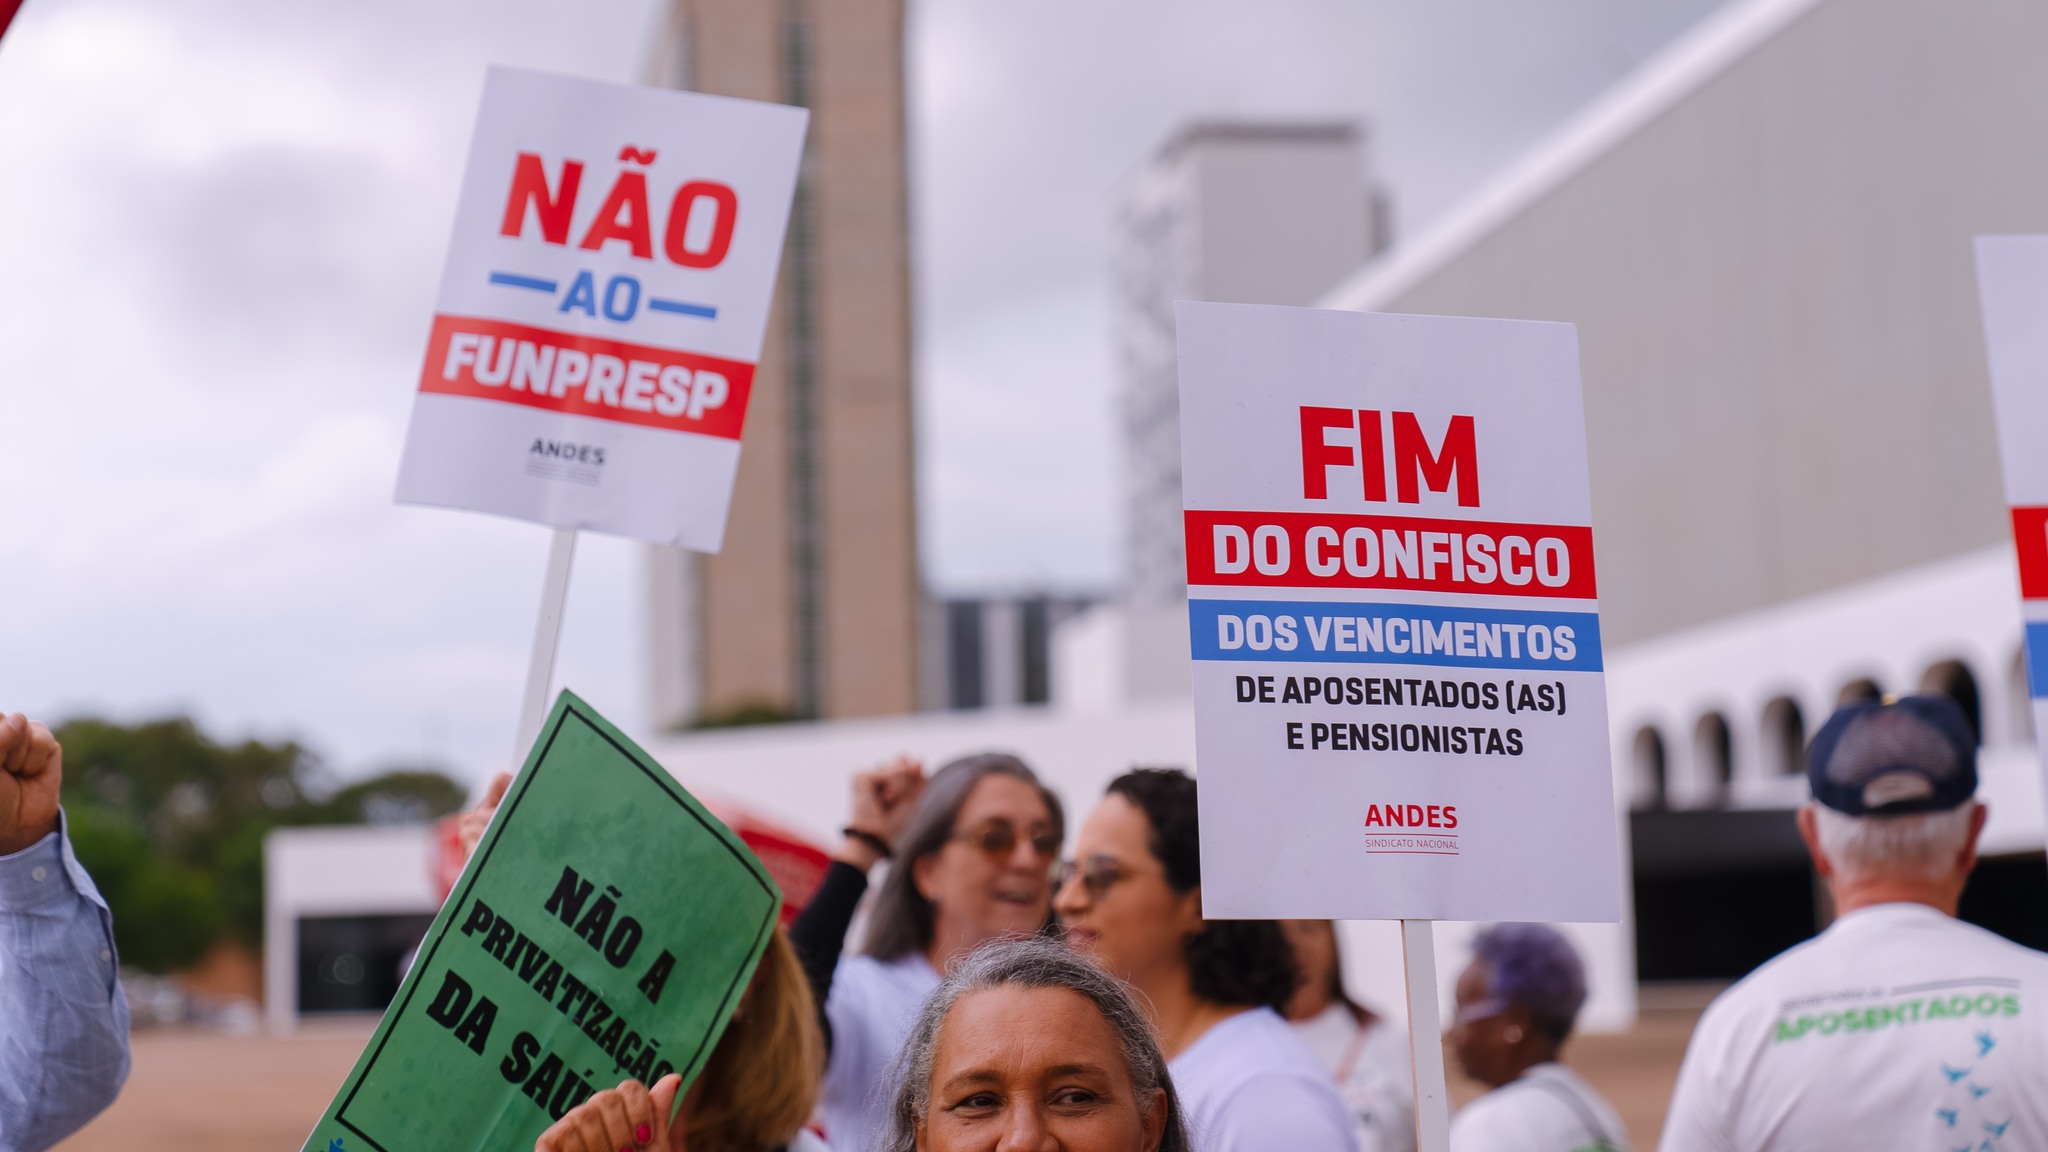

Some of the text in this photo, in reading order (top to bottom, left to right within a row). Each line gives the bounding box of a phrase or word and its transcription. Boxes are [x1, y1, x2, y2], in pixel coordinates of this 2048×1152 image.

[501, 145, 739, 270] NÃO
[558, 270, 642, 324] AO
[442, 331, 729, 420] FUNPRESP
[529, 437, 606, 466] ANDES
[1299, 405, 1480, 508] FIM
[1212, 524, 1571, 588] DO CONFISCO
[1217, 614, 1577, 661] DOS VENCIMENTOS
[1235, 675, 1566, 716] DE APOSENTADOS (AS)
[1286, 722, 1524, 756] E PENSIONISTAS
[1364, 803, 1458, 829] ANDES
[1365, 839, 1460, 850] SINDICATO NACIONAL
[544, 865, 677, 1006] NÃO A
[1775, 994, 2022, 1043] APOSENTADOS
[426, 968, 597, 1122] DA SAÚ
